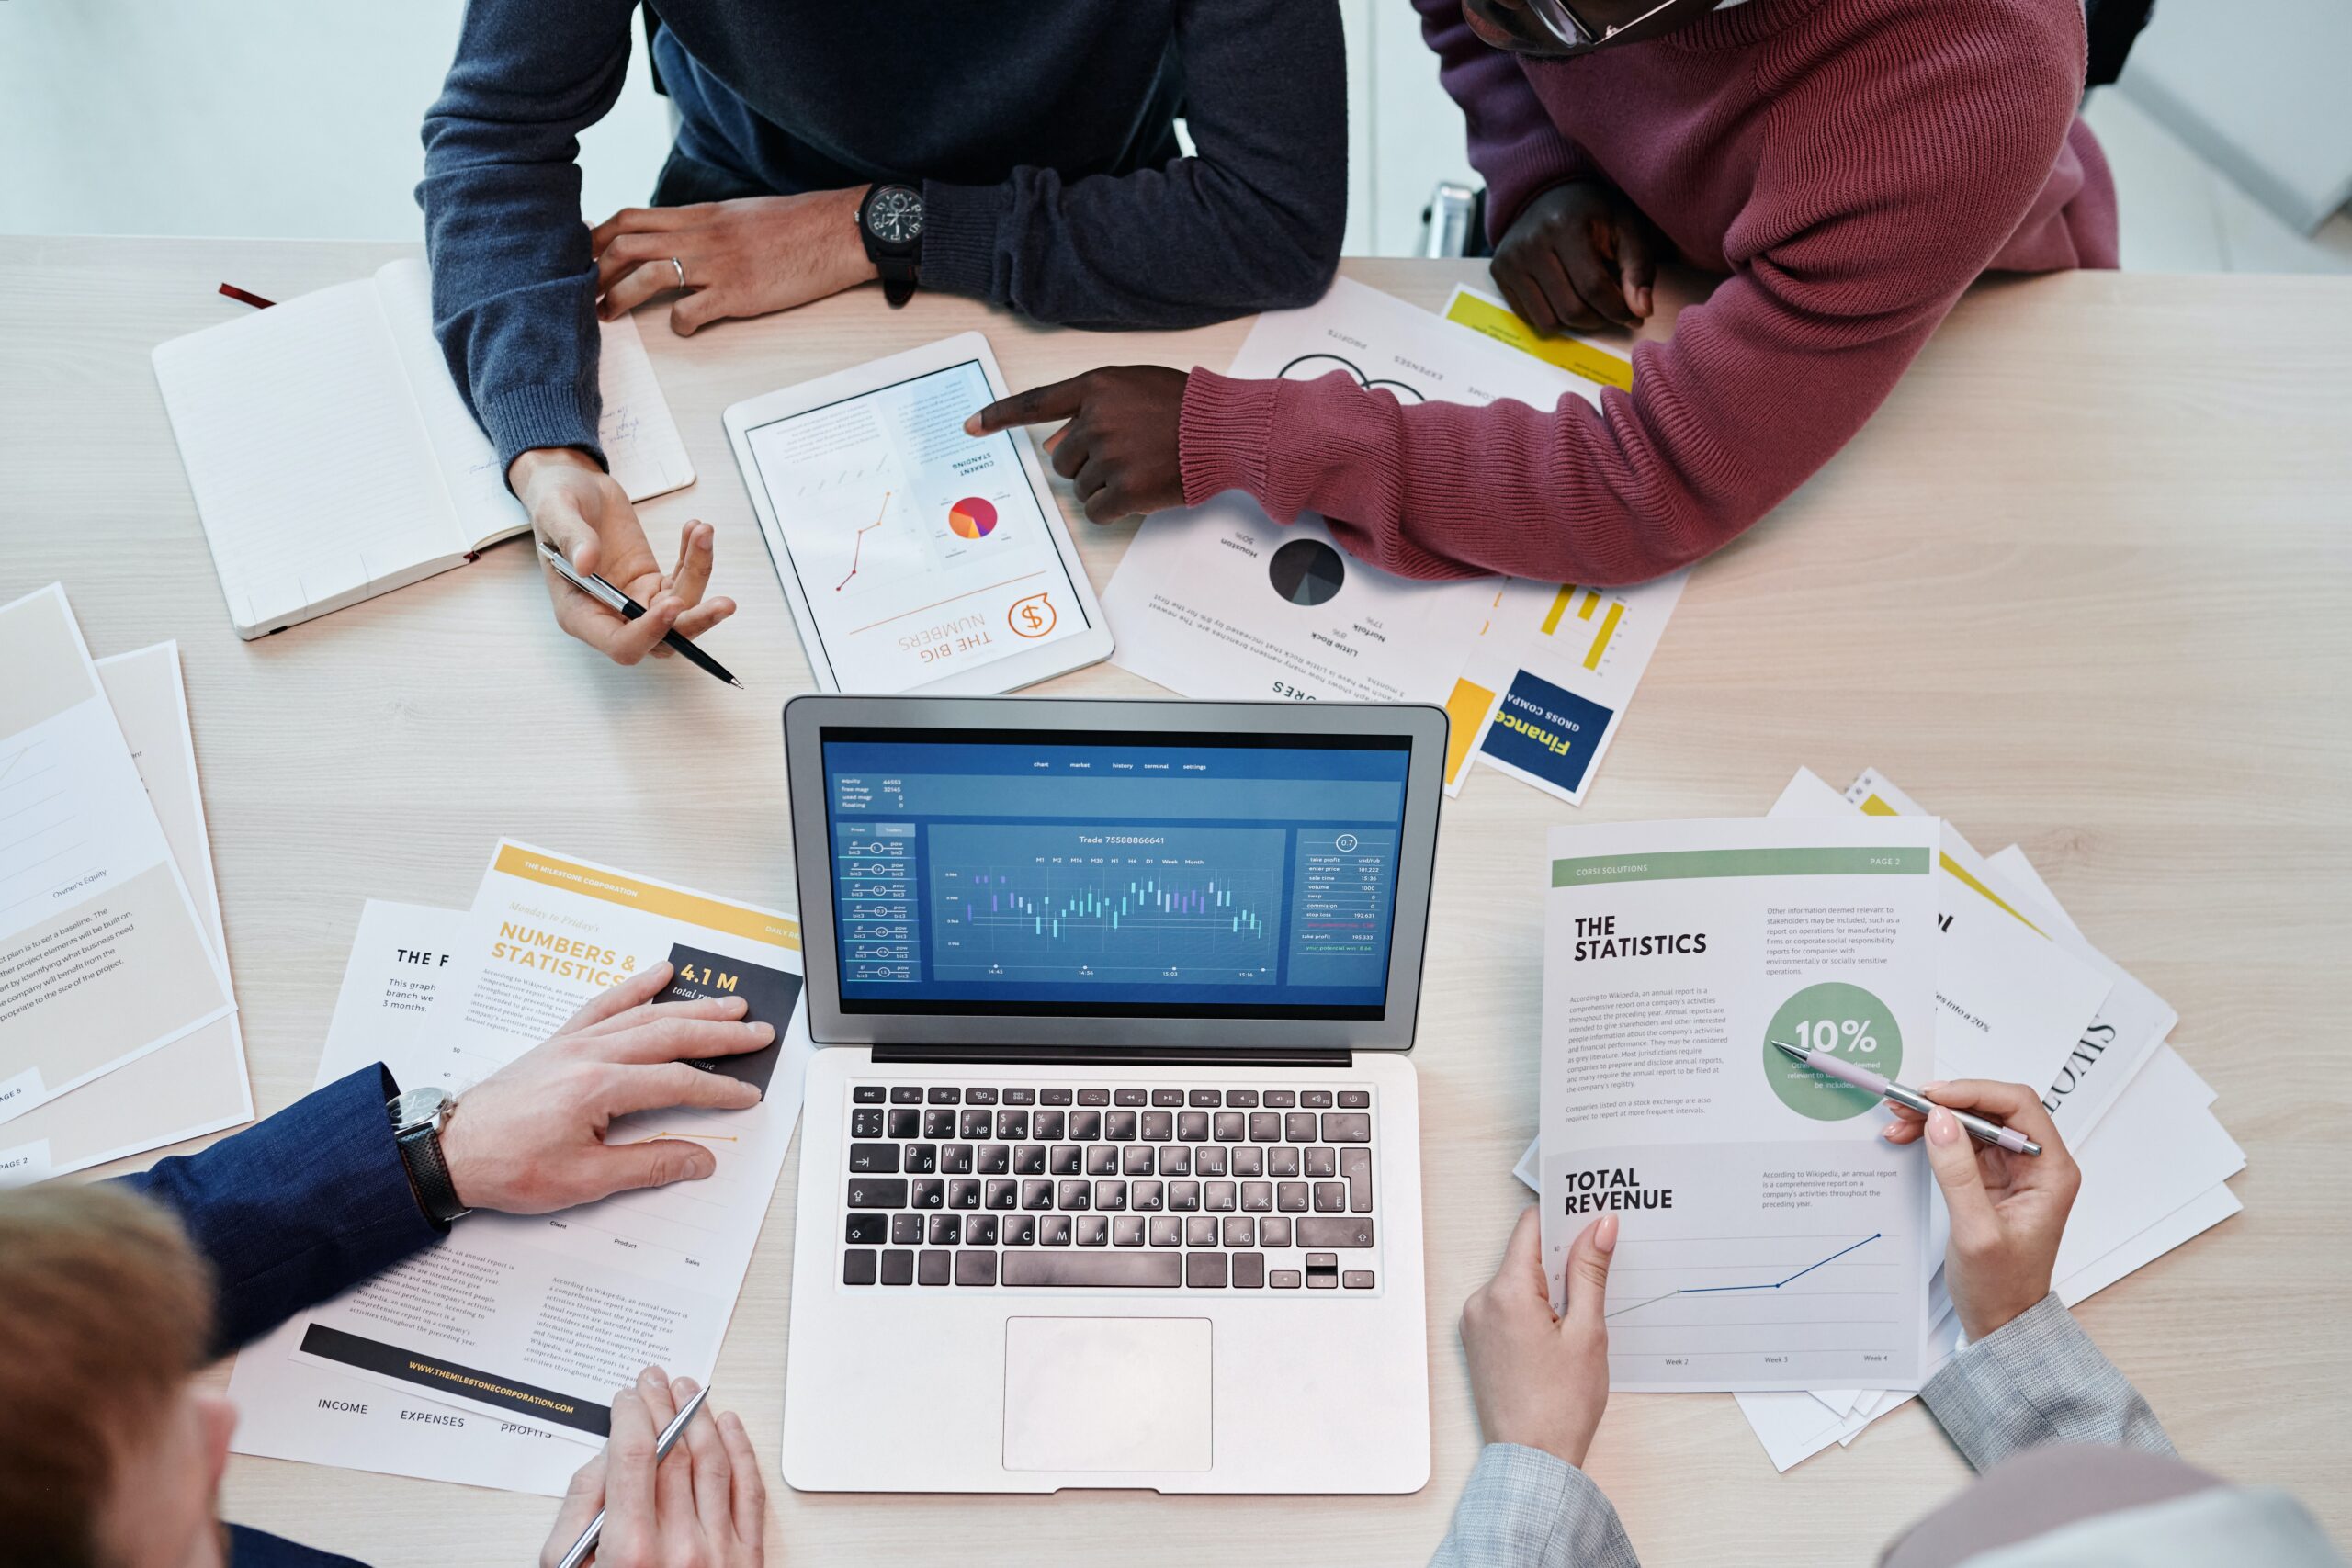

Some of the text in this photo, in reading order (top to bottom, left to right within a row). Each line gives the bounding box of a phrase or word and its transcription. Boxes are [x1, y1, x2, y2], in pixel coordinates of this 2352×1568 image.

[1327, 328, 1368, 350] PROFITS
[1393, 355, 1444, 381] EXPENSES
[952, 452, 992, 470] STANDING
[959, 460, 995, 477] CURRENT
[1220, 537, 1258, 559] Houston
[899, 612, 986, 650] NUMBERS
[1352, 623, 1386, 643] Norfolk
[920, 631, 993, 664] THE BIG
[1310, 631, 1358, 657] Little Rock
[1544, 711, 1580, 733] GROSS
[1493, 710, 1571, 756] Finance
[1079, 836, 1103, 844] Trade
[1575, 863, 1647, 876] CORSI SOLUTIONS
[1870, 857, 1900, 865] PAGE 2
[52, 869, 106, 898] Owner's Equity
[524, 861, 638, 897] THE MILESTONE CORPORATION
[508, 900, 599, 932] Monday to Friday's
[1766, 907, 1786, 915] Other
[1766, 917, 1808, 925] stakeholders
[1836, 916, 1867, 924] included,
[6, 948, 24, 961] plan
[40, 934, 52, 943] set
[58, 917, 92, 935] baseline.
[92, 908, 107, 918] The
[1574, 915, 1616, 939] THE
[1766, 928, 1786, 936] report
[1798, 927, 1834, 935] operations
[1847, 926, 1896, 935] manufacturing
[16, 911, 132, 971] project elements will be built on.
[499, 920, 637, 973] NUMBERS &
[1573, 932, 1708, 962] STATISTICS
[1792, 937, 1826, 945] corporate
[1848, 936, 1894, 945] responsibility
[397, 949, 450, 967] THE F
[1765, 956, 1820, 965] environmentally
[1830, 956, 1856, 964] socially
[1802, 947, 1838, 955] companies
[680, 964, 739, 992] 4.1 M
[1765, 967, 1802, 976] operations.
[385, 988, 417, 999] branch
[389, 978, 435, 991] This graph
[672, 986, 697, 998] total
[390, 1002, 426, 1011] months.
[1971, 1017, 1992, 1033] 20%
[1795, 1020, 1877, 1053] 10%
[923, 1157, 933, 1168] Й
[959, 1160, 968, 1171] Ц
[1566, 1168, 1640, 1193] TOTAL
[1762, 1170, 1795, 1179] According
[1805, 1169, 1840, 1179] Wikipedia,
[1565, 1190, 1673, 1215] REVENUE
[548, 1220, 568, 1231] Client
[614, 1237, 638, 1249] Product
[684, 1258, 701, 1268] Sales
[408, 1359, 575, 1415] WWW.THEMILESTONECORPORATION.COM
[318, 1399, 368, 1415] INCOME
[400, 1410, 465, 1427] EXPENSES
